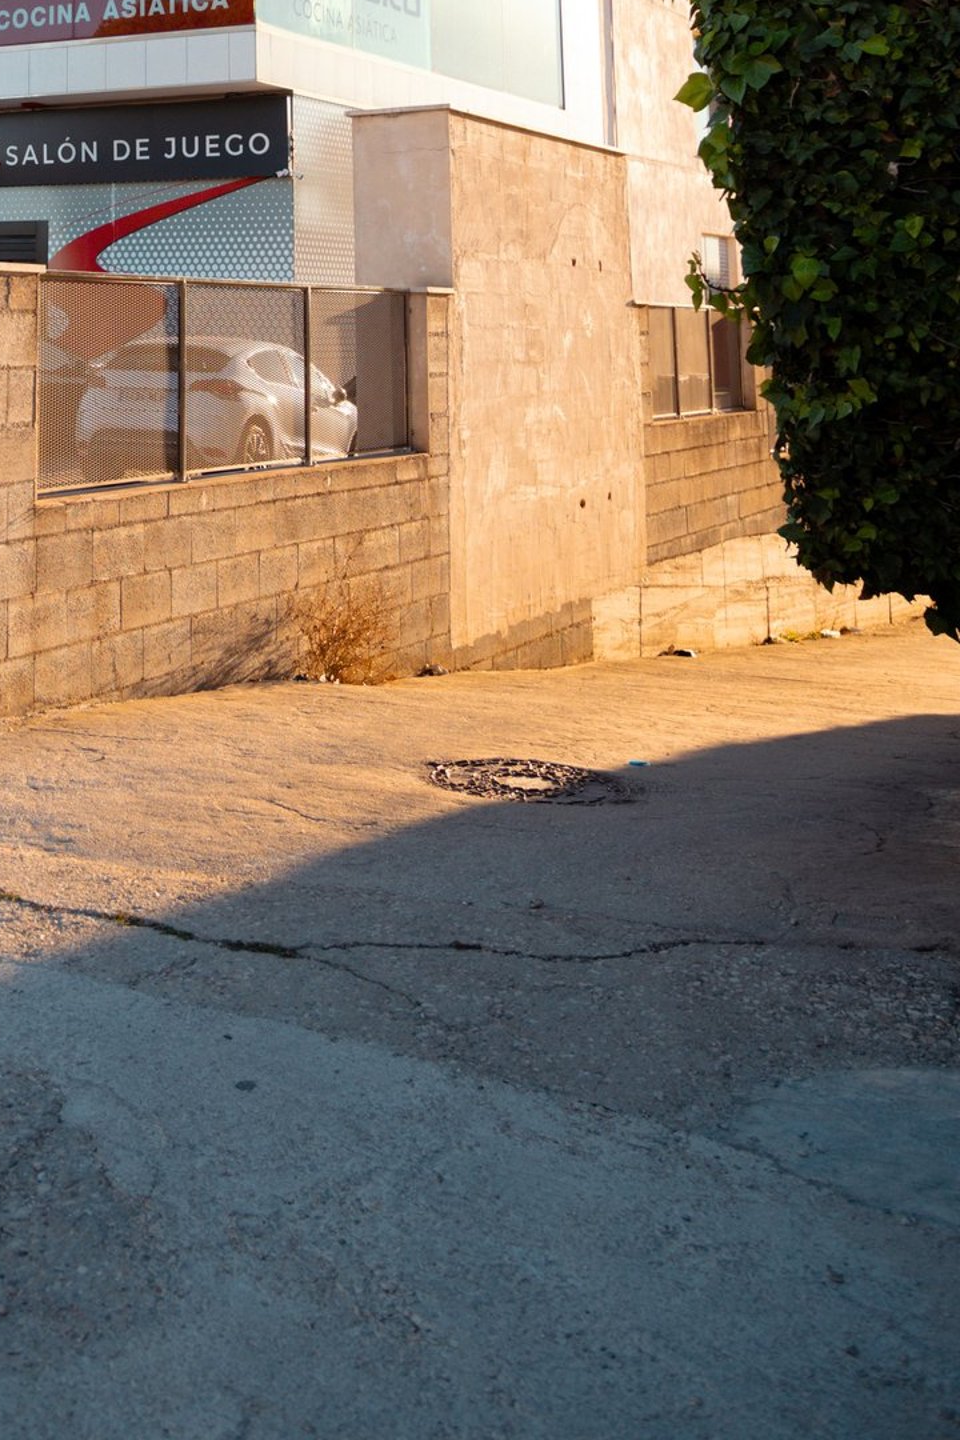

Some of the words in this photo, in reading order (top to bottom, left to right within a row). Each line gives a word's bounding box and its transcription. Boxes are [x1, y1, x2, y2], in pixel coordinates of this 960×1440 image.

[5, 135, 99, 166] SALÓN
[113, 138, 150, 162] DE
[164, 132, 271, 159] JUEGO
